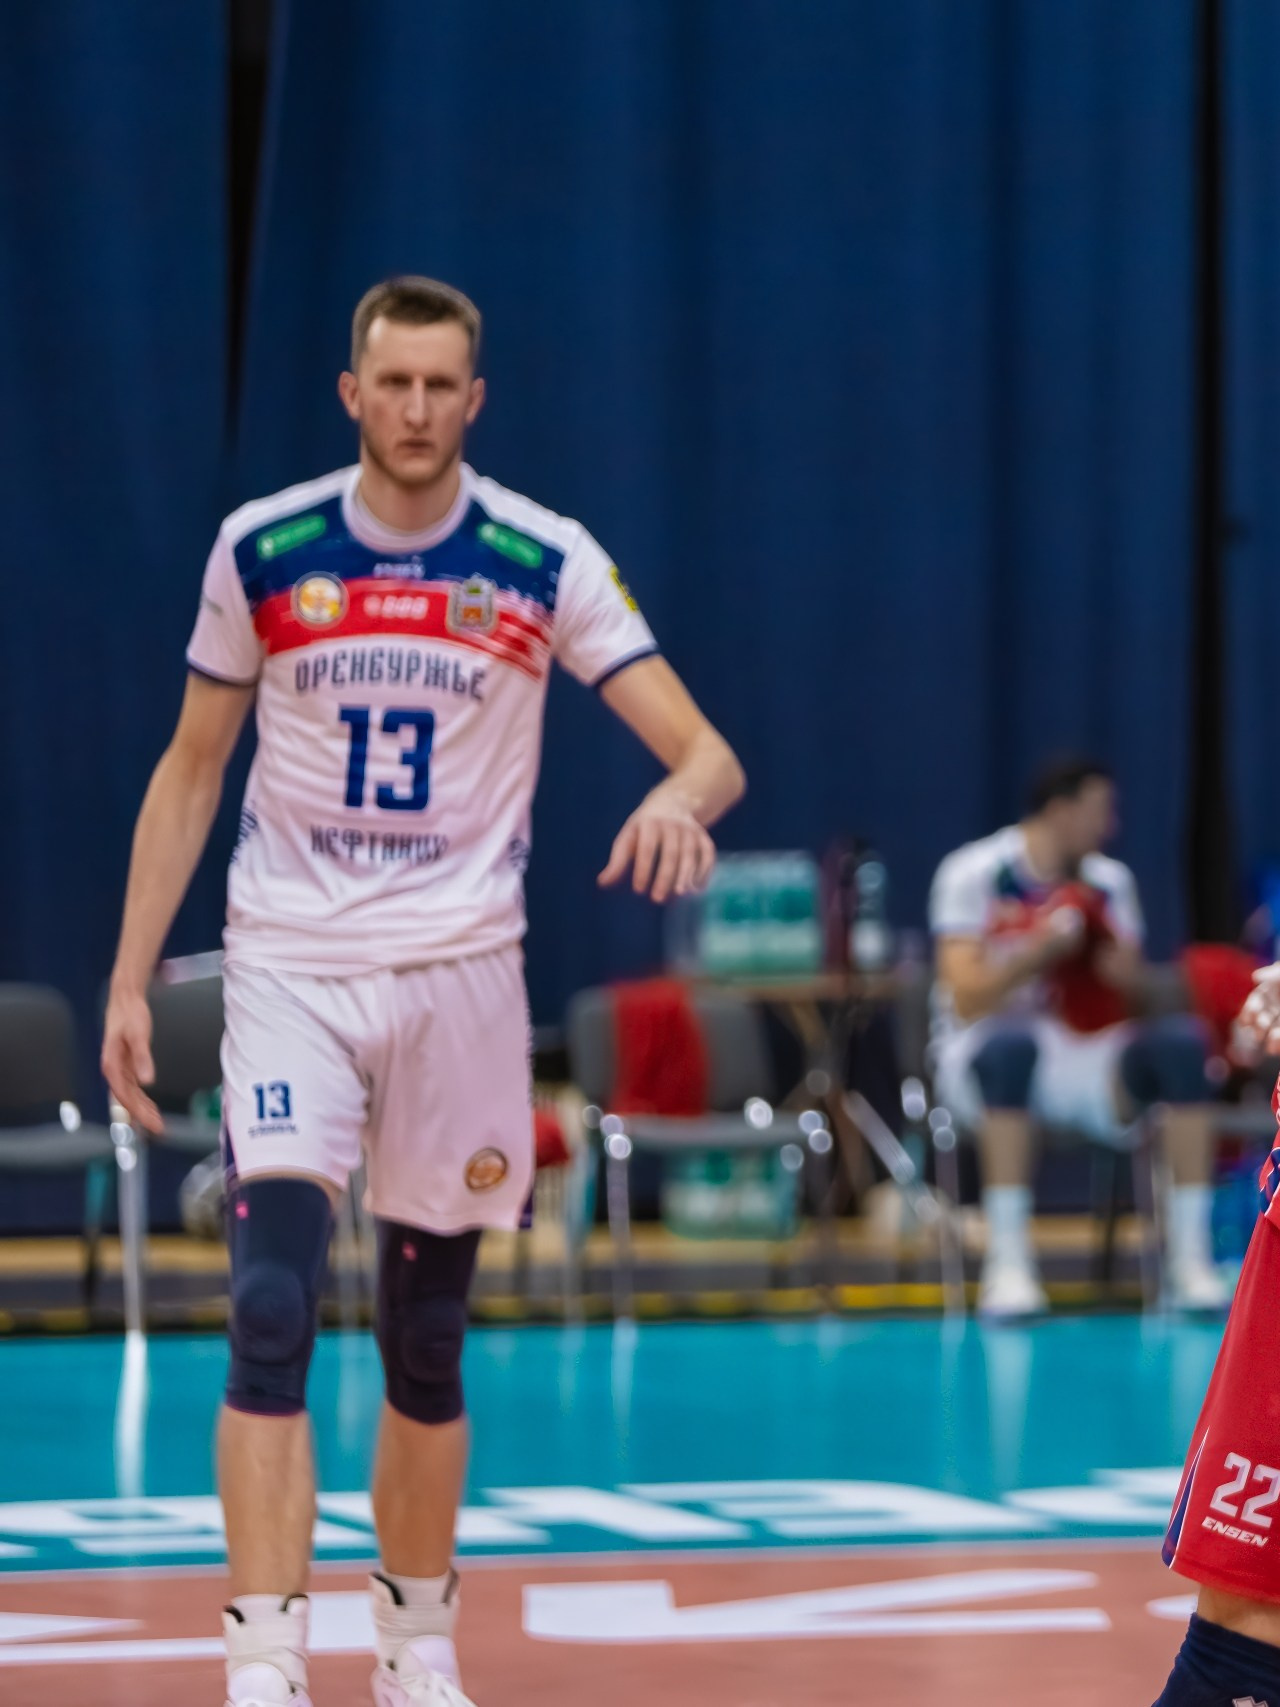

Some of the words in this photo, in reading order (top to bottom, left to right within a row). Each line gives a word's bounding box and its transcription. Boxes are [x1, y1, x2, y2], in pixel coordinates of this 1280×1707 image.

[294, 646, 487, 701] ОРЕНБУРЖЬЕ
[339, 704, 435, 812] 13
[253, 1080, 291, 1120] 13
[1201, 1516, 1269, 1548] ENSEN
